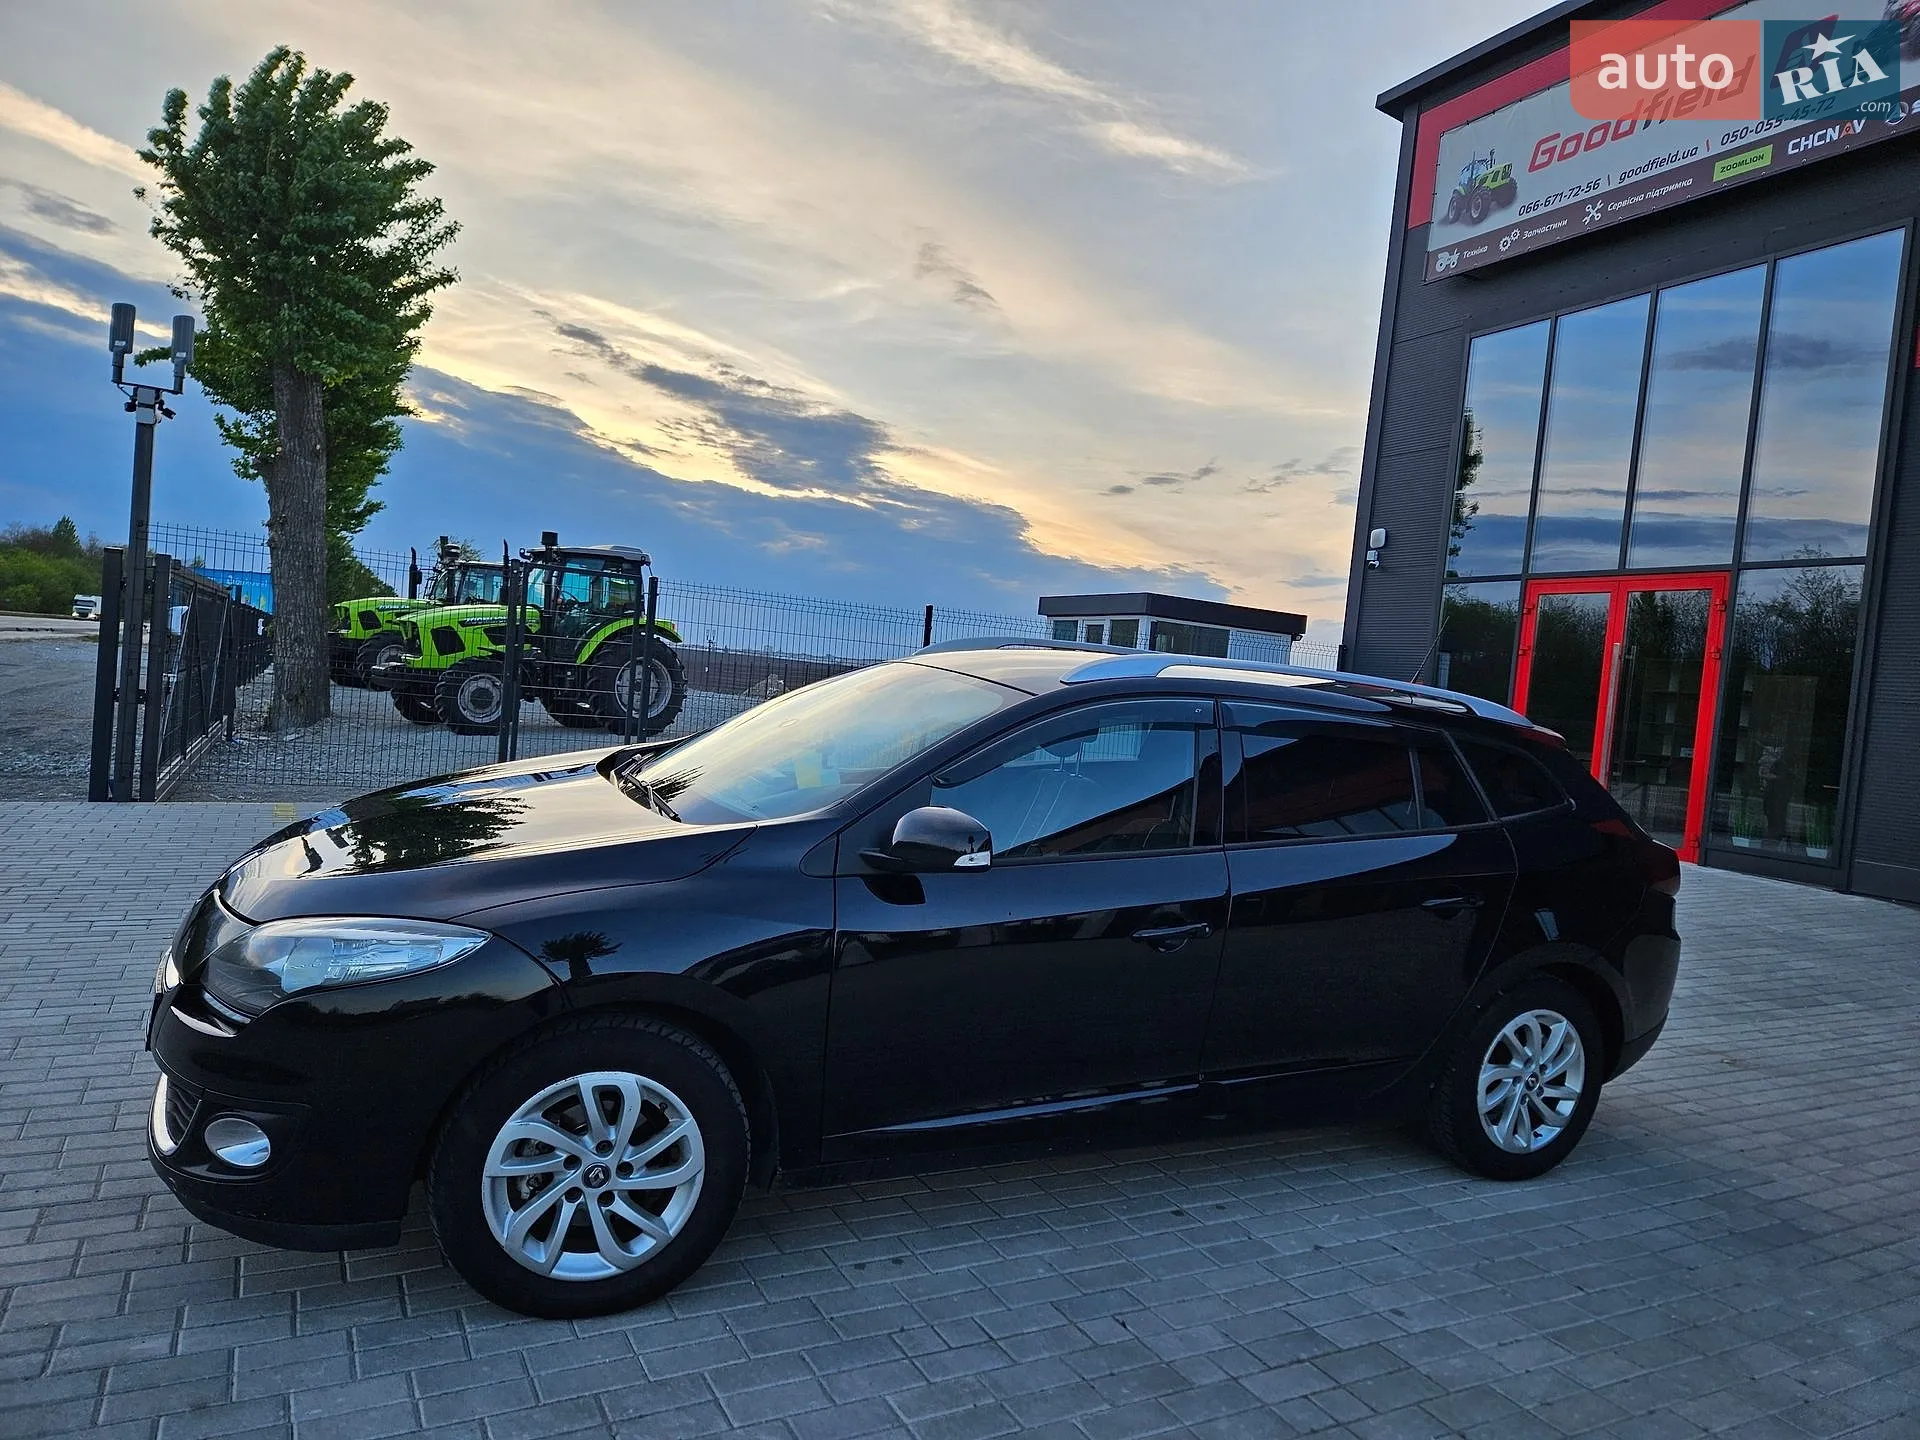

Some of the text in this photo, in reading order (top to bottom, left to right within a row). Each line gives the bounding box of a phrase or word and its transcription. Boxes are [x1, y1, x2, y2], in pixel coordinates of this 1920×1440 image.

[1528, 54, 1757, 173] Goodfield
[1787, 116, 1867, 155] CHCNAV
[1518, 178, 1600, 216] 066-671-72-56
[1618, 146, 1698, 184] goodfield.ua
[1720, 153, 1764, 174] ZOOMLION
